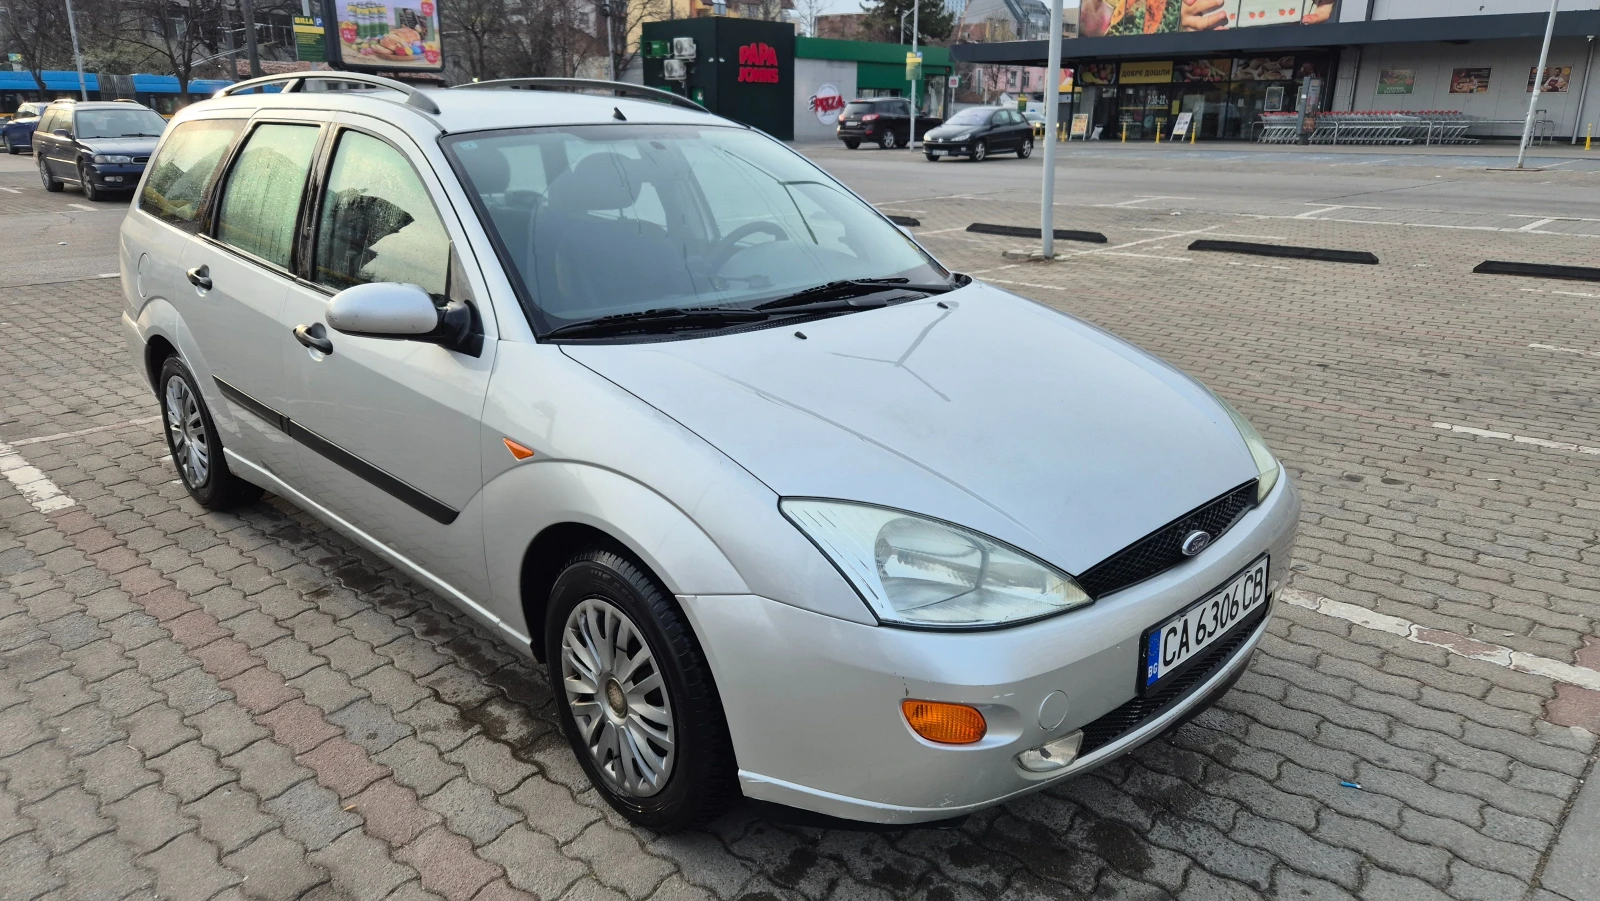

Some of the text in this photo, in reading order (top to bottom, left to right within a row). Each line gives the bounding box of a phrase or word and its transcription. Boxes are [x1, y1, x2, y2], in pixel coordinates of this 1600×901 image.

[316, 18, 322, 26] P
[739, 43, 778, 66] PAPA
[738, 67, 779, 83] JOHNS
[1121, 68, 1170, 77] ДОБРЕ ДОШЛИ
[815, 95, 845, 112] PIZZA
[1162, 566, 1264, 667] CA 6306 CB
[1148, 662, 1158, 678] BG
